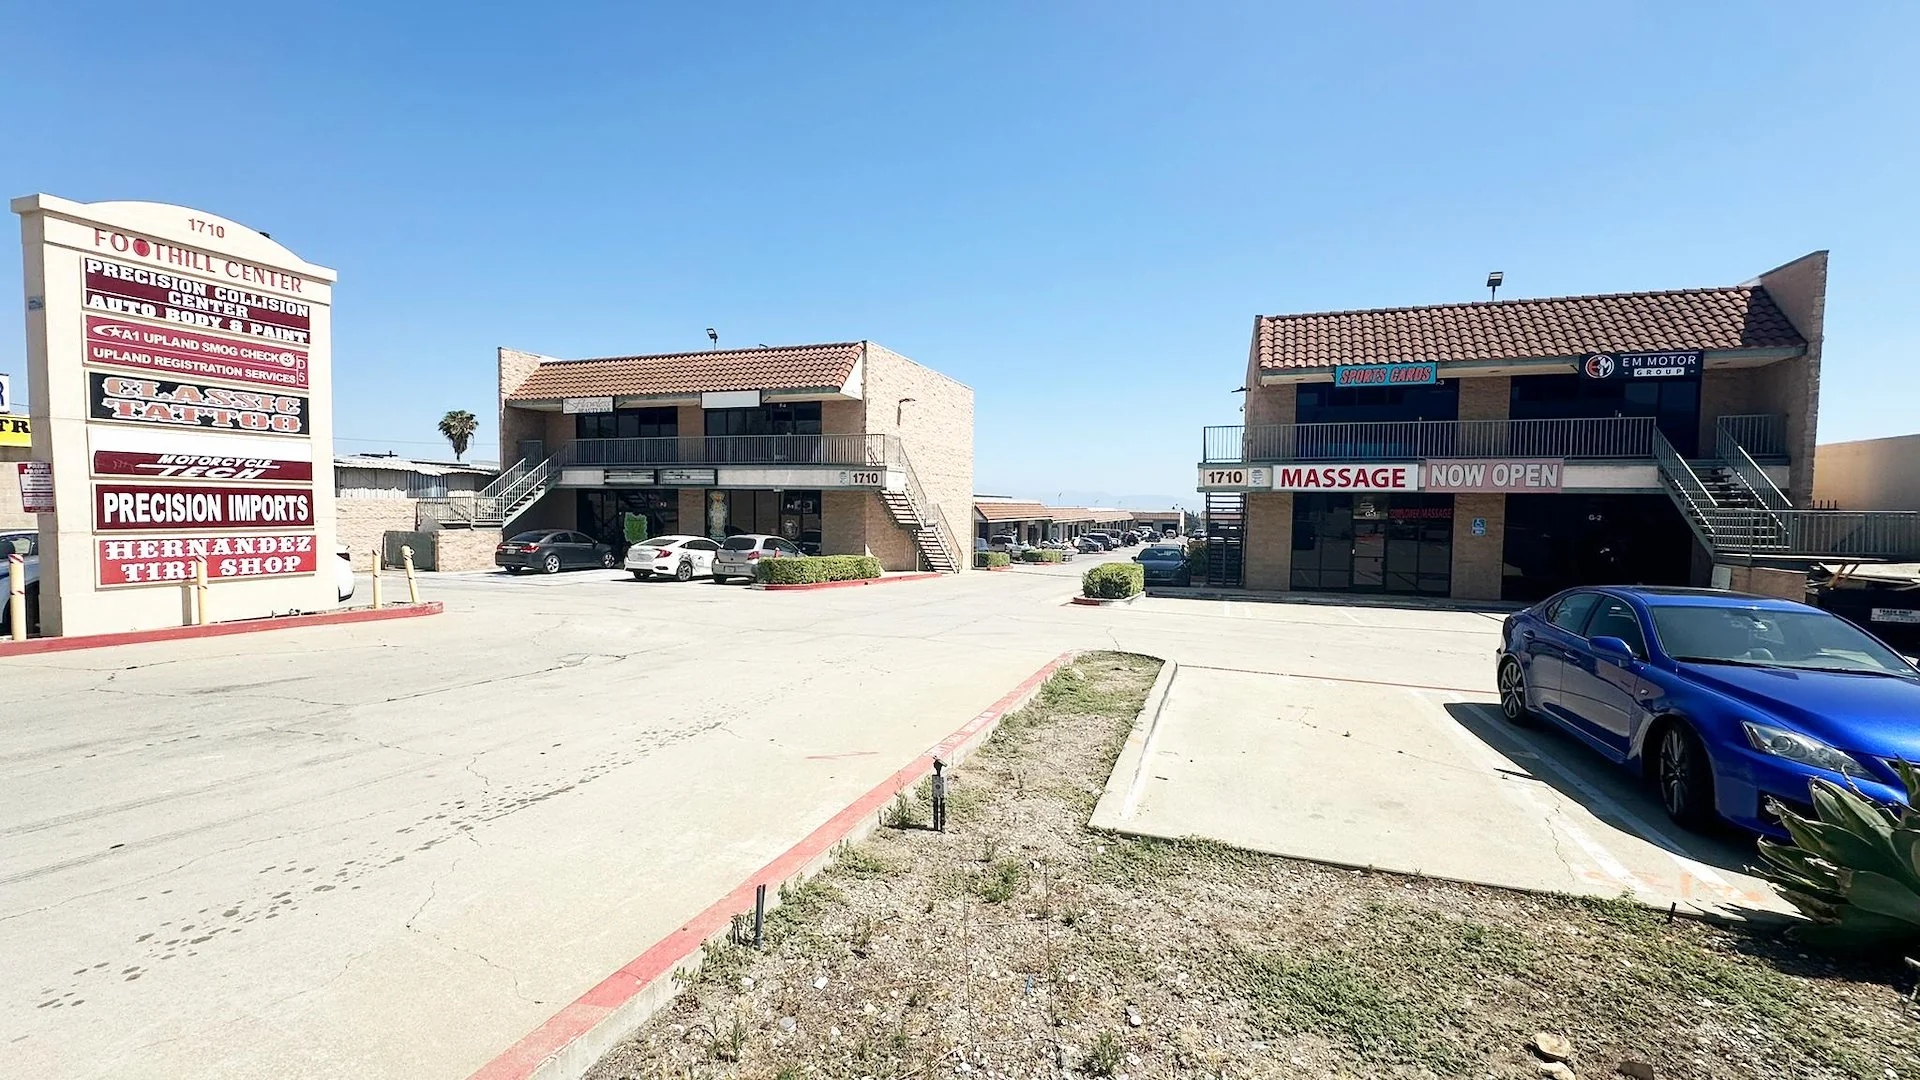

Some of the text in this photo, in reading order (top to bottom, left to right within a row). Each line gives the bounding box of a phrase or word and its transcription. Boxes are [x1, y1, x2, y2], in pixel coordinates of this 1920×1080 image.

[188, 218, 225, 238] 1710
[95, 228, 302, 293] FOOTHILL CENTER
[86, 258, 309, 318] PRECISION COLLISION
[168, 290, 249, 318] CENTER
[88, 293, 307, 344] AUTO BODY & PAINT
[122, 329, 280, 364] A1 UPLAND SMOG CHECK
[93, 347, 297, 384] UPLAND REGISTRATION SERVICES
[1622, 355, 1697, 367] EM MOTOR
[1636, 368, 1682, 376] GROUP
[1340, 366, 1432, 384] SPORTS CARDS
[102, 376, 301, 415] CLASSIC
[101, 397, 302, 433] TATTOO
[156, 454, 273, 468] MOTORCYCLE
[157, 466, 267, 479] TECH
[853, 472, 878, 484] 1710
[1208, 471, 1243, 484] 1710
[1281, 468, 1406, 488] MASSAGE
[1430, 464, 1559, 488] NOW OPEN
[103, 492, 309, 523] PRECISION IMPORTS
[105, 536, 312, 560] HERNANDEZ
[219, 555, 301, 577] SHOP
